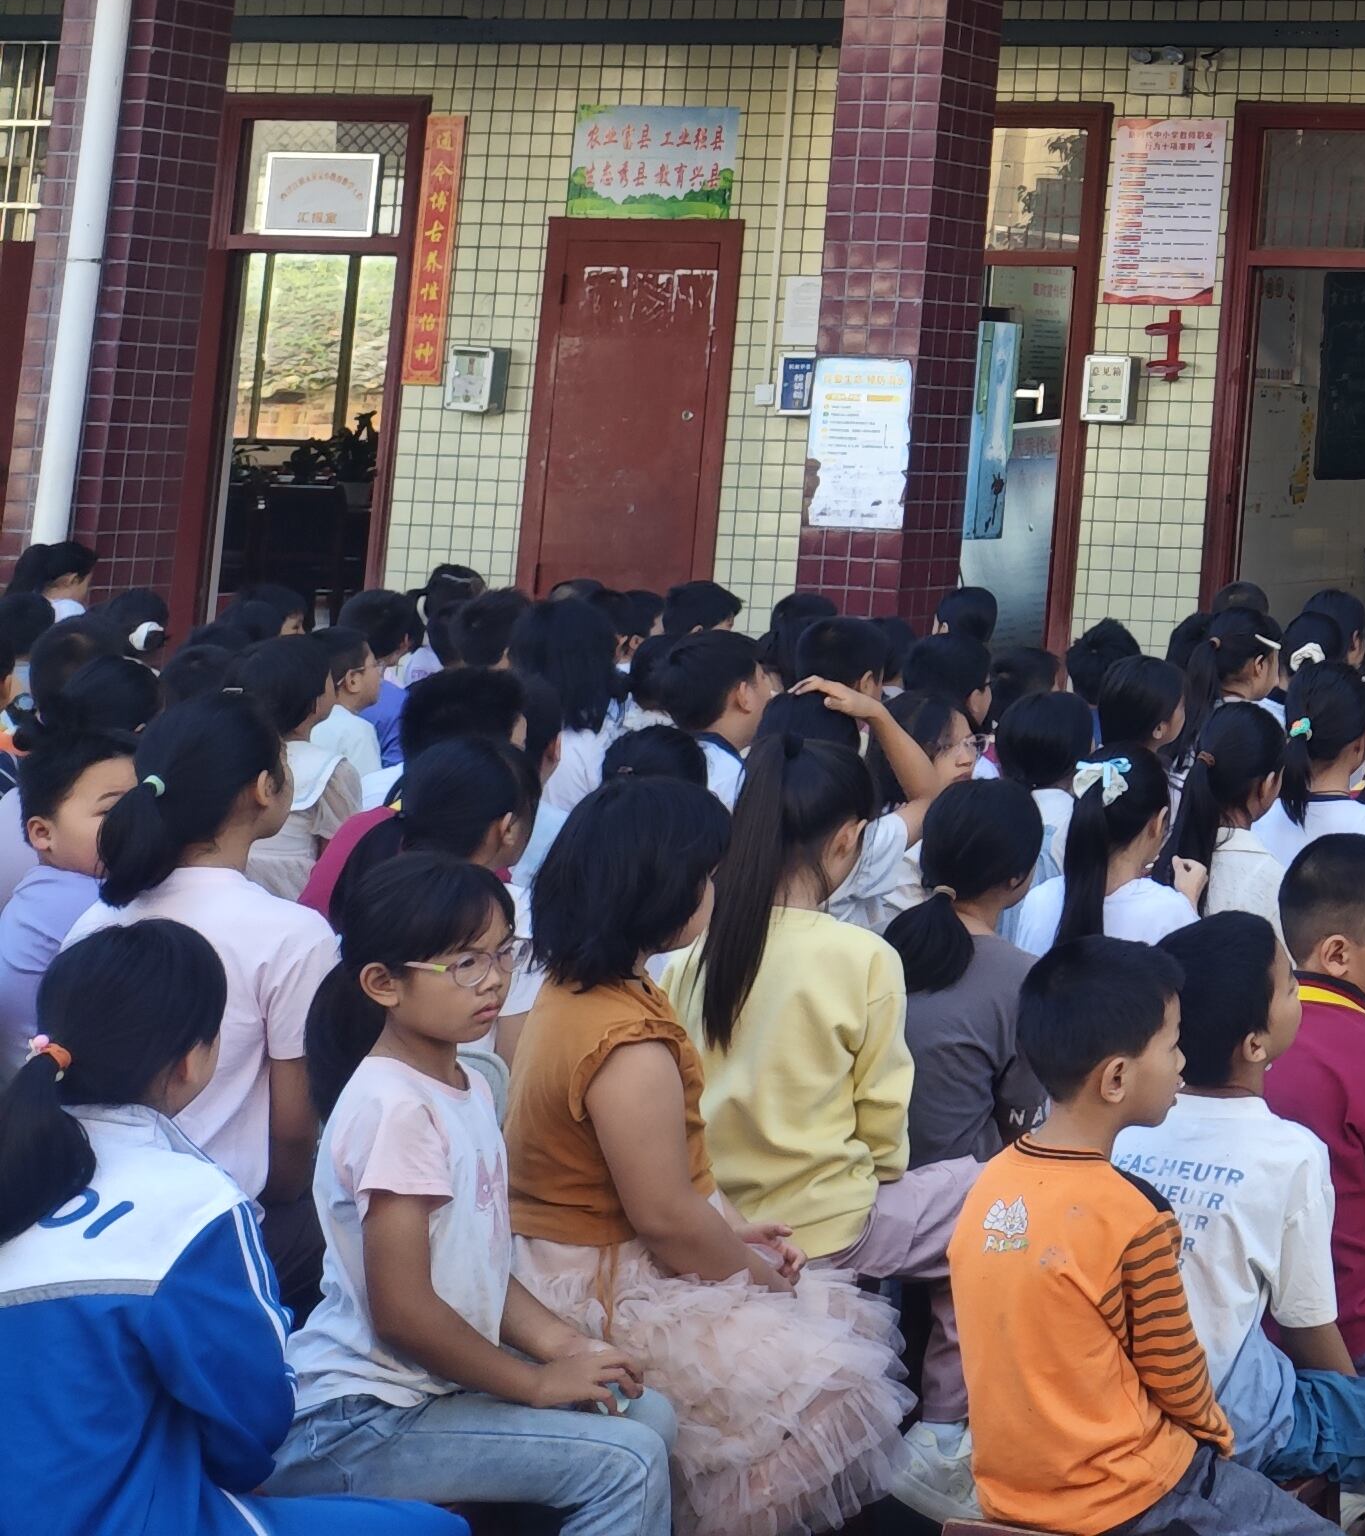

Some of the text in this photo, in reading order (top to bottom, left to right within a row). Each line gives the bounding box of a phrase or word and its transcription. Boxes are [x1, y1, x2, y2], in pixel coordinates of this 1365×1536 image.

[586, 123, 725, 152] 农业富县 工业强县
